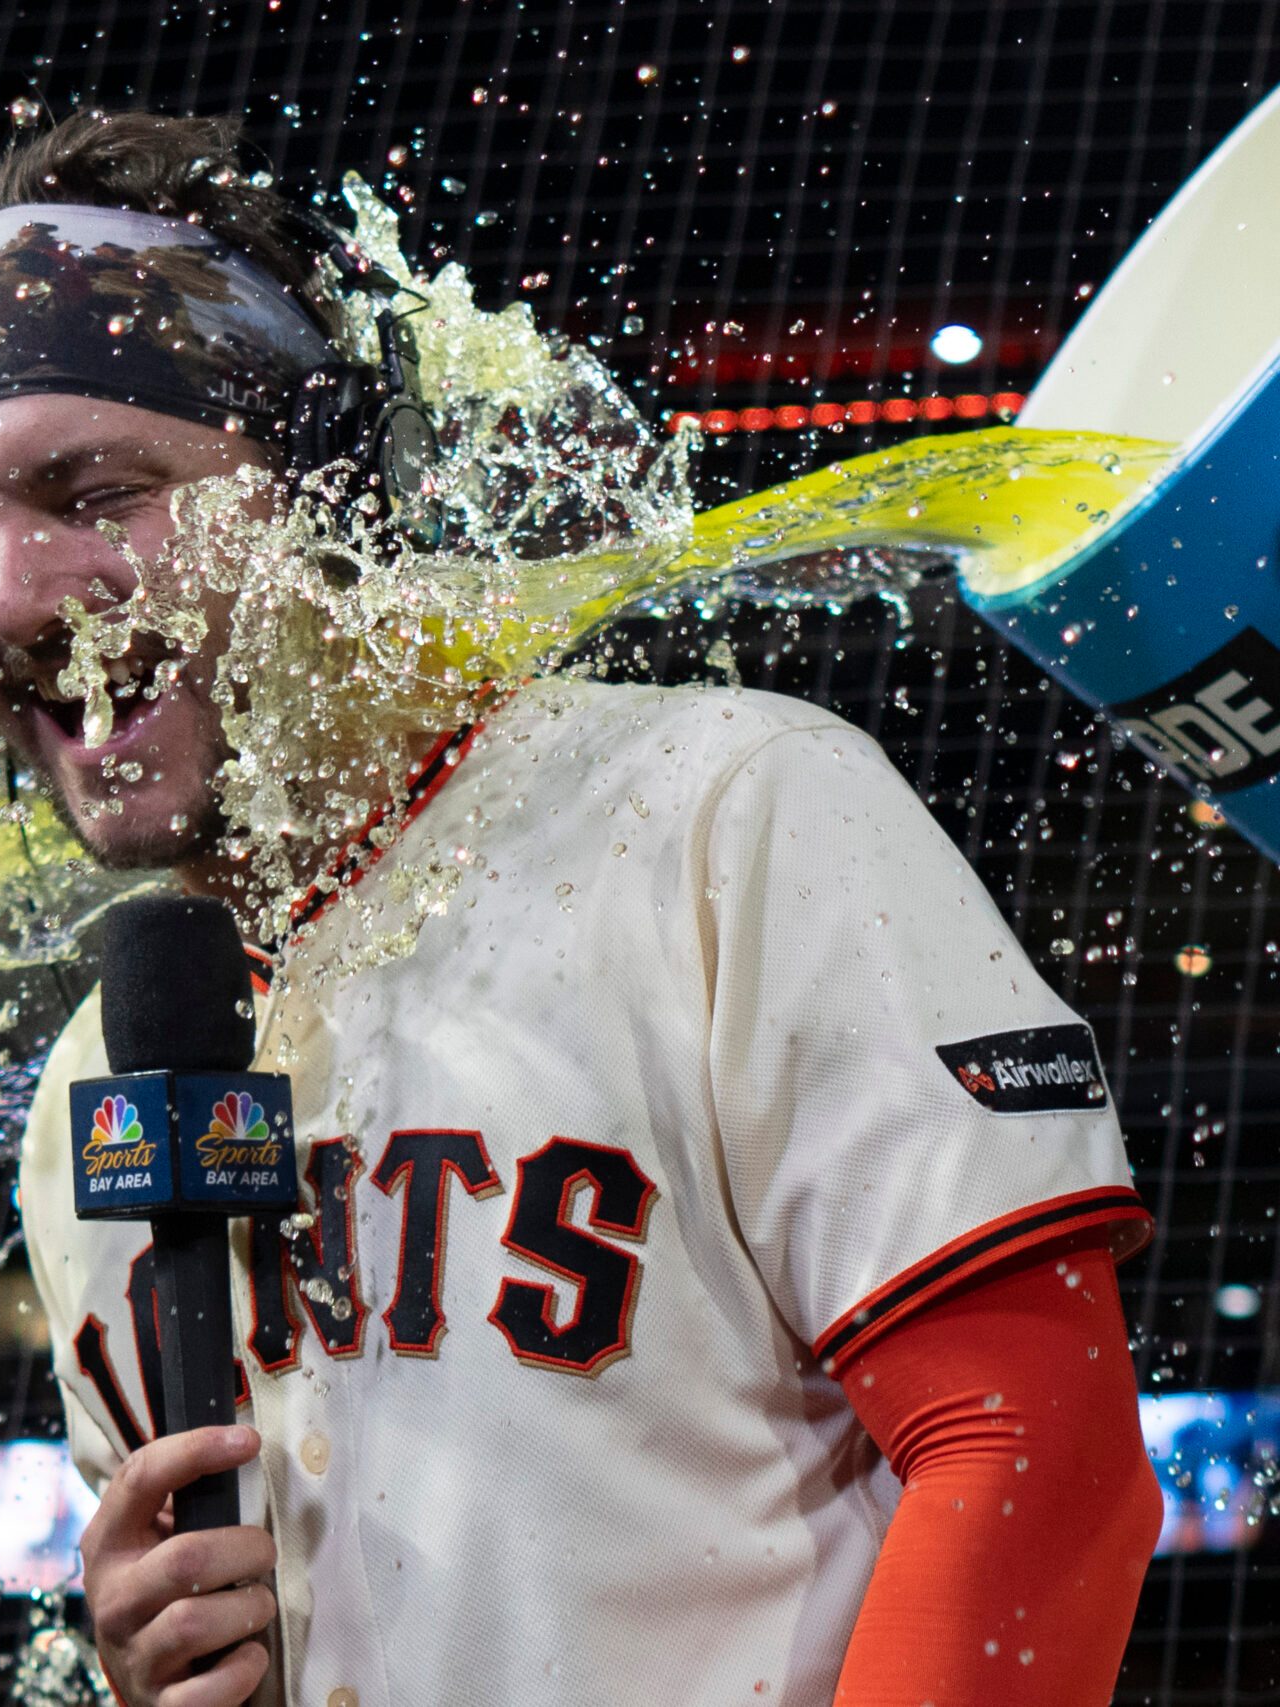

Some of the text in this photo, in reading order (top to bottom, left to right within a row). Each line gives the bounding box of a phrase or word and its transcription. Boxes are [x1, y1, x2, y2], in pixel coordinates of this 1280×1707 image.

[993, 1053, 1097, 1090] Airwallex
[82, 1139, 157, 1178] Sports
[195, 1132, 283, 1173] Sports
[89, 1172, 152, 1193] BAY AREA
[206, 1170, 279, 1186] BAY AREA
